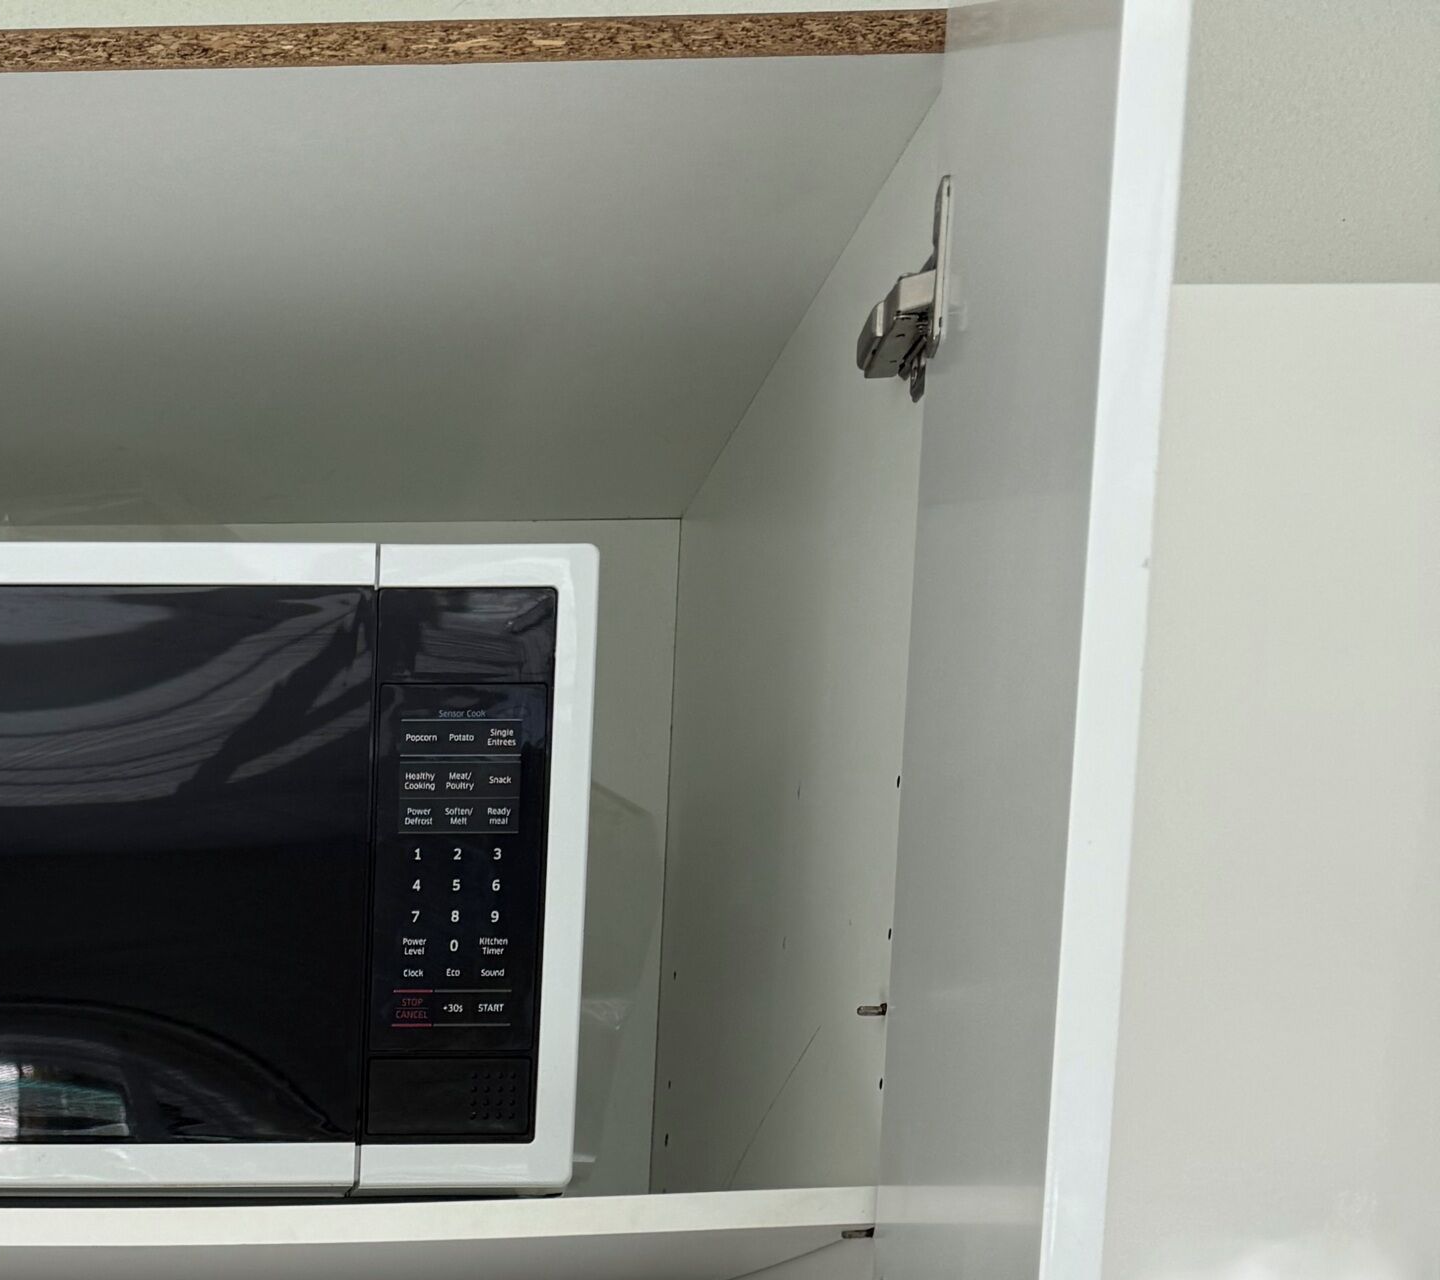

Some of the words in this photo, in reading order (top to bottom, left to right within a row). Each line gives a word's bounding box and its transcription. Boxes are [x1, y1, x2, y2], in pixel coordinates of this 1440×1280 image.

[438, 710, 464, 718] Sensor
[466, 709, 486, 718] Cook
[405, 733, 438, 742] Popcorn
[449, 733, 475, 742] Potato
[490, 728, 514, 738] Single
[487, 738, 517, 746] Entrees
[405, 772, 436, 782] Healthy
[449, 772, 472, 780] Meat/
[489, 776, 512, 784] Snack
[404, 782, 436, 791] Cooking
[446, 782, 474, 791] Poultry
[407, 808, 431, 816] Power
[444, 807, 473, 816] Soften/
[487, 807, 511, 817] Ready
[404, 817, 433, 825] Defrost
[450, 817, 467, 825] Melt
[489, 817, 508, 825] meal
[414, 848, 421, 860] 1
[453, 848, 462, 860] 2
[493, 848, 502, 860] 3
[412, 879, 421, 891] 4
[452, 879, 460, 891] 5
[491, 879, 500, 891] 6
[411, 911, 420, 922] 7
[451, 910, 460, 922] 8
[490, 910, 499, 922] 9
[402, 937, 427, 945] Power
[450, 939, 459, 952] 0
[479, 937, 508, 946] Kitchen
[404, 947, 425, 955] Level
[482, 947, 504, 955] Timer
[403, 969, 424, 977] Clock
[446, 968, 460, 977] Eco
[480, 968, 505, 977] Sound
[402, 998, 423, 1007] STOP
[478, 1004, 504, 1012] START
[395, 1010, 428, 1019] CANCEL
